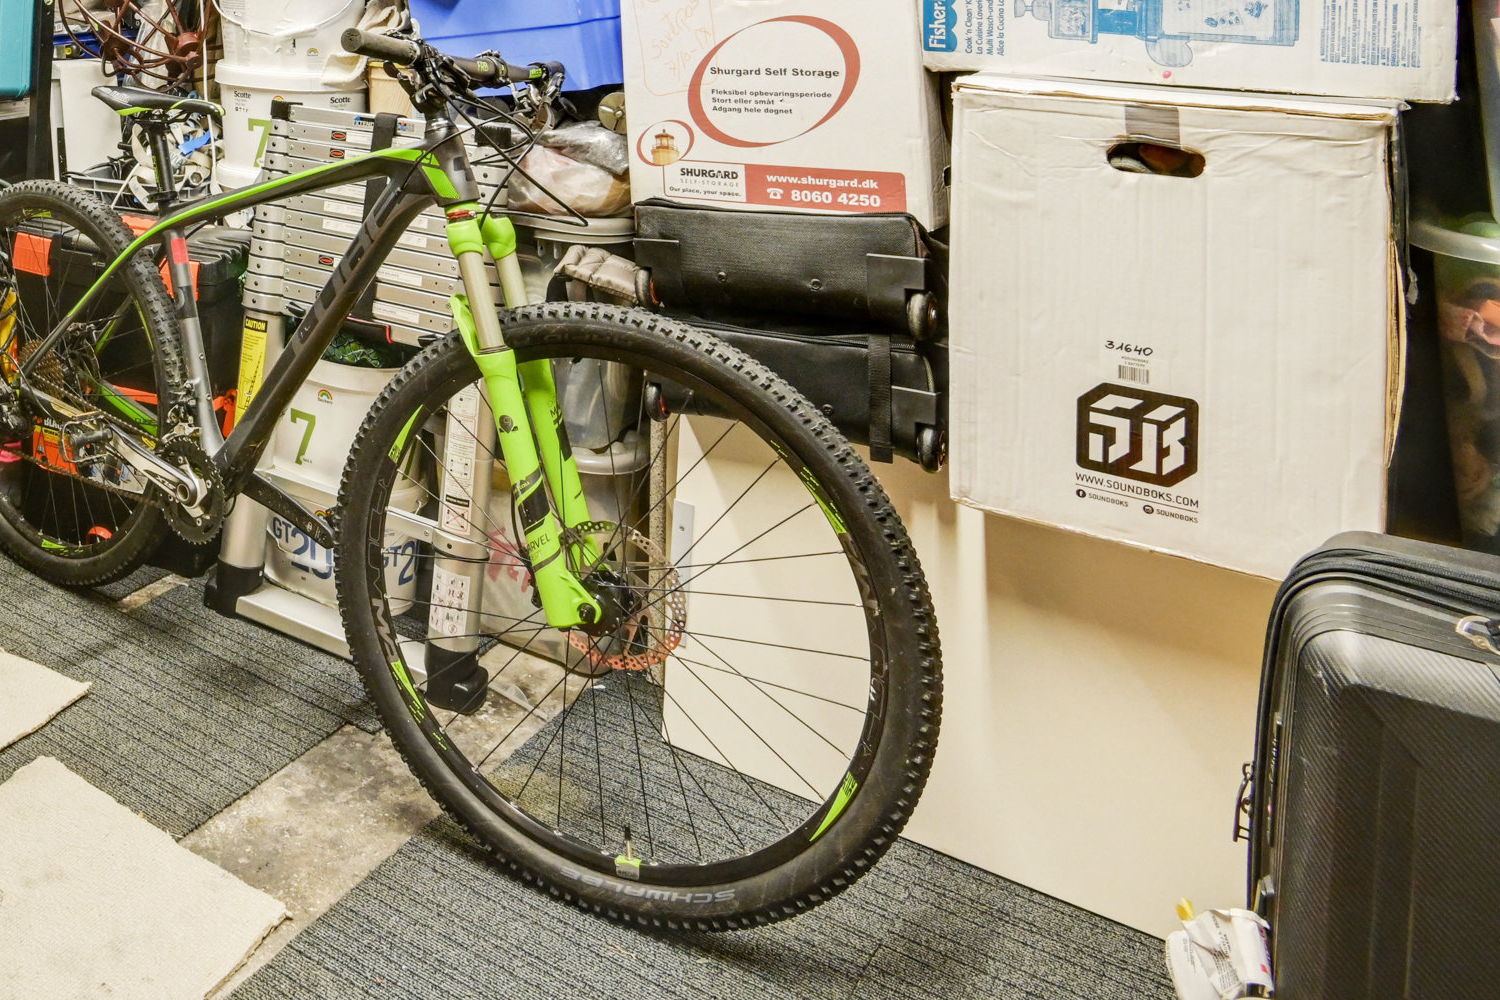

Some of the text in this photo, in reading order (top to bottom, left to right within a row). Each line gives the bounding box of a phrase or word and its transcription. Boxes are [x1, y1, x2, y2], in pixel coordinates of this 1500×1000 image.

[997, 8, 1005, 31] Cucina
[976, 21, 984, 45] Cuisine
[965, 37, 973, 54] Cook
[976, 46, 983, 55] La
[710, 66, 840, 79] Shurgard Self Storage
[711, 88, 832, 98] Fleksibel opbevaringsperiode
[711, 96, 731, 104] Stort
[712, 105, 742, 113] Adgang
[248, 118, 272, 167] 7
[680, 167, 739, 180] SHURGARD
[680, 178, 740, 188] SELF-STORAGE
[766, 174, 879, 189] www.shurgard.dk
[681, 187, 702, 195] place,
[791, 189, 881, 207] 8060 4250
[245, 318, 266, 331] CAUTION
[290, 407, 317, 466] 7
[1075, 472, 1199, 509] WWW.SOUNDBOKS.COM
[1088, 492, 1129, 508] SOUNDBOKS
[1156, 508, 1199, 524] SOUNDBOKS
[560, 866, 736, 903] SCHWALBE
